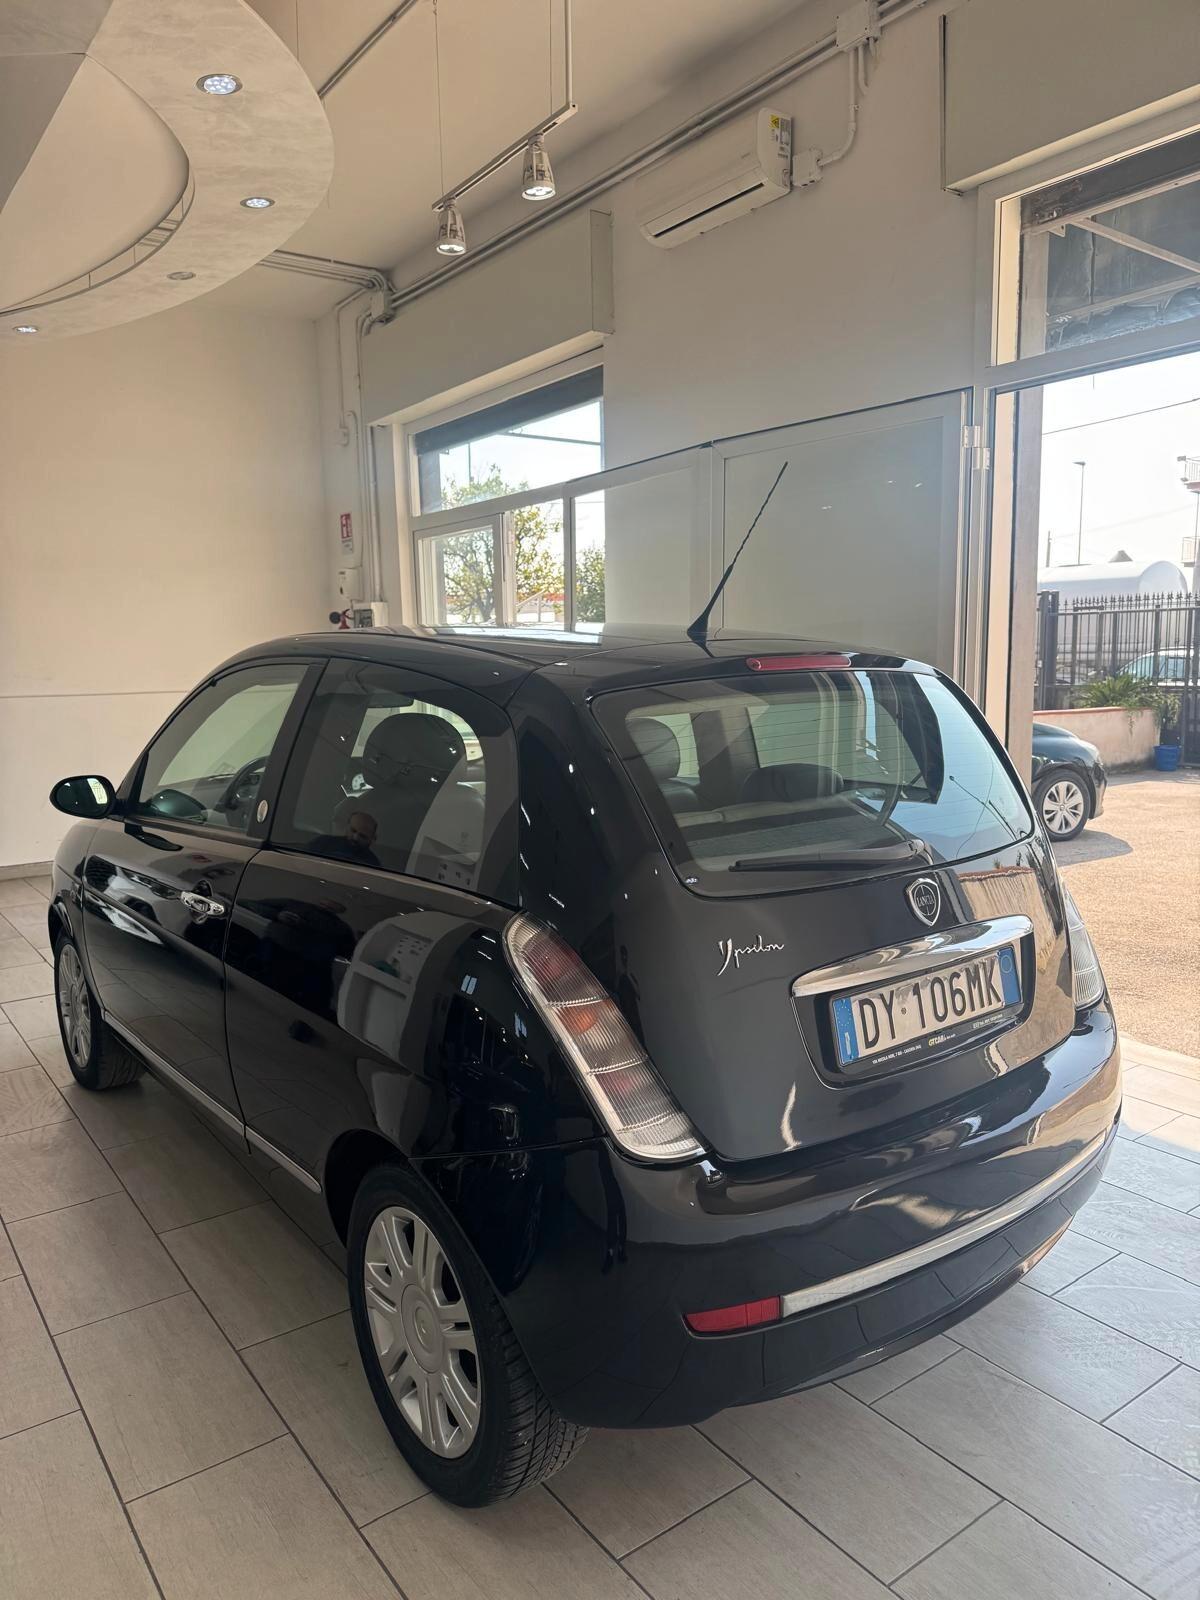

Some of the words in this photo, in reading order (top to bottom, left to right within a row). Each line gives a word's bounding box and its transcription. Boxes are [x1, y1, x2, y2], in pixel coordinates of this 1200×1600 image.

[717, 935, 785, 976] Ypsilon
[858, 993, 897, 1050] DY
[913, 958, 1001, 1030] 106MK
